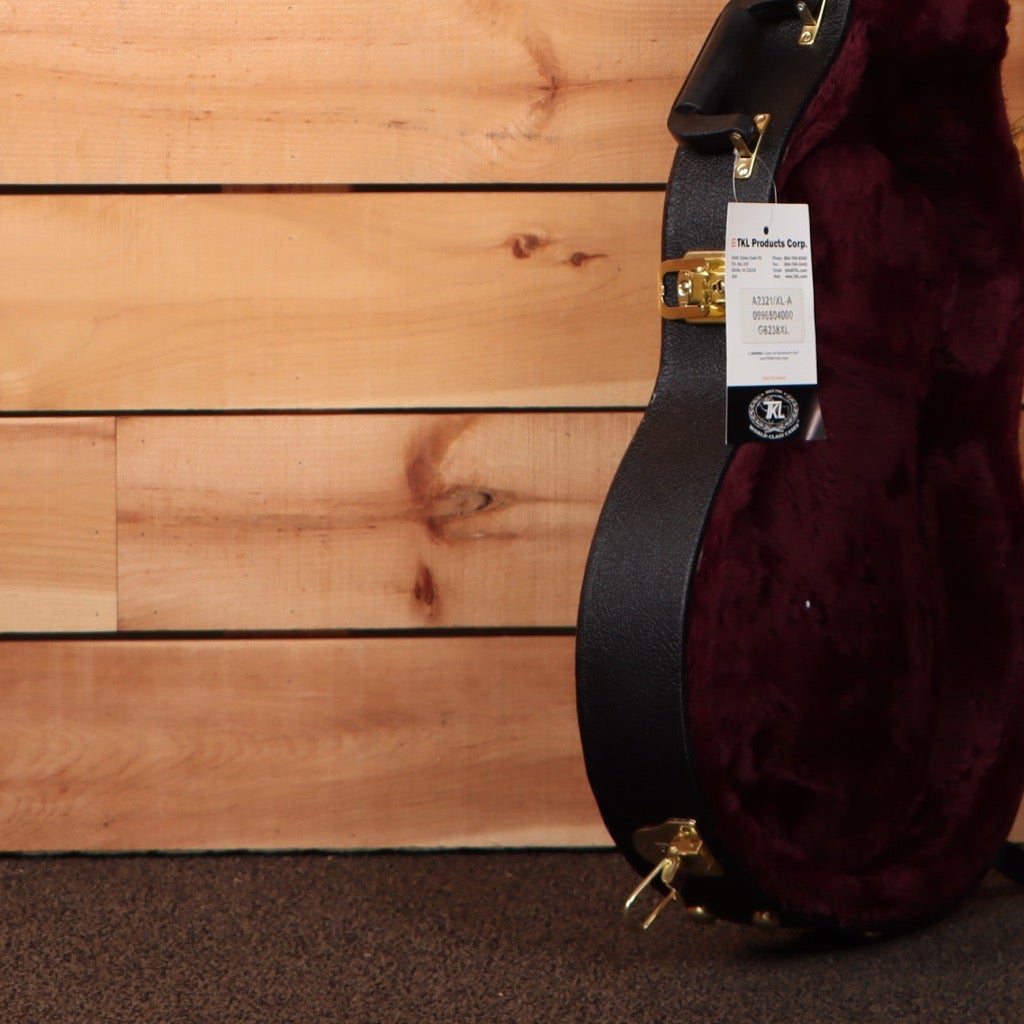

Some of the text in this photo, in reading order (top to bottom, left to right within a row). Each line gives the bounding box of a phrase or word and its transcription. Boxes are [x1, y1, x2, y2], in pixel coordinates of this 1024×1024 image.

[737, 238, 808, 250] TKL Products Corp.
[763, 401, 786, 419] TKL
